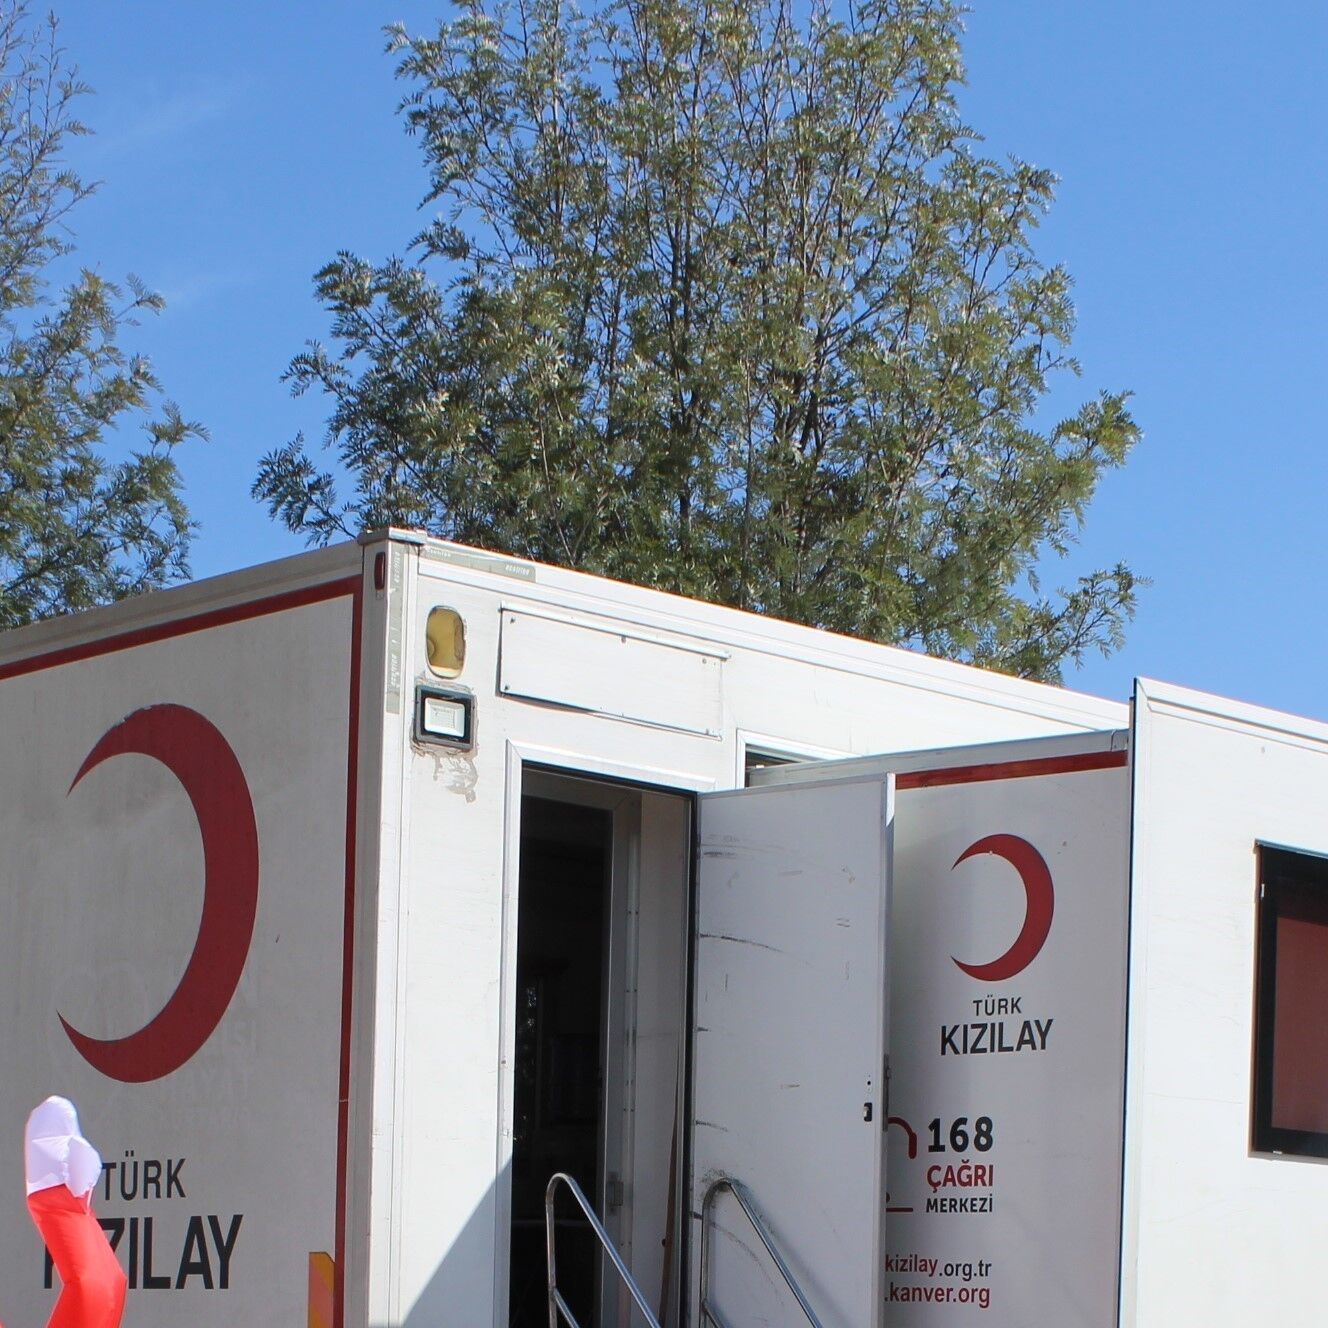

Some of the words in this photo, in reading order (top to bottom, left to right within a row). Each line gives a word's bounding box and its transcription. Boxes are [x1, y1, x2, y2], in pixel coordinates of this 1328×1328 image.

[973, 995, 1022, 1016] TÜRK
[940, 1019, 1054, 1056] KIZILAY
[927, 1116, 994, 1153] 168
[101, 1150, 187, 1201] TÜRK
[926, 1159, 994, 1193] ÇAĞRI
[925, 1193, 993, 1214] MERKEZİ
[43, 1214, 244, 1290] ZILAY
[885, 1254, 992, 1283] kizilay.org.tr
[884, 1283, 991, 1309] .kanver.org
